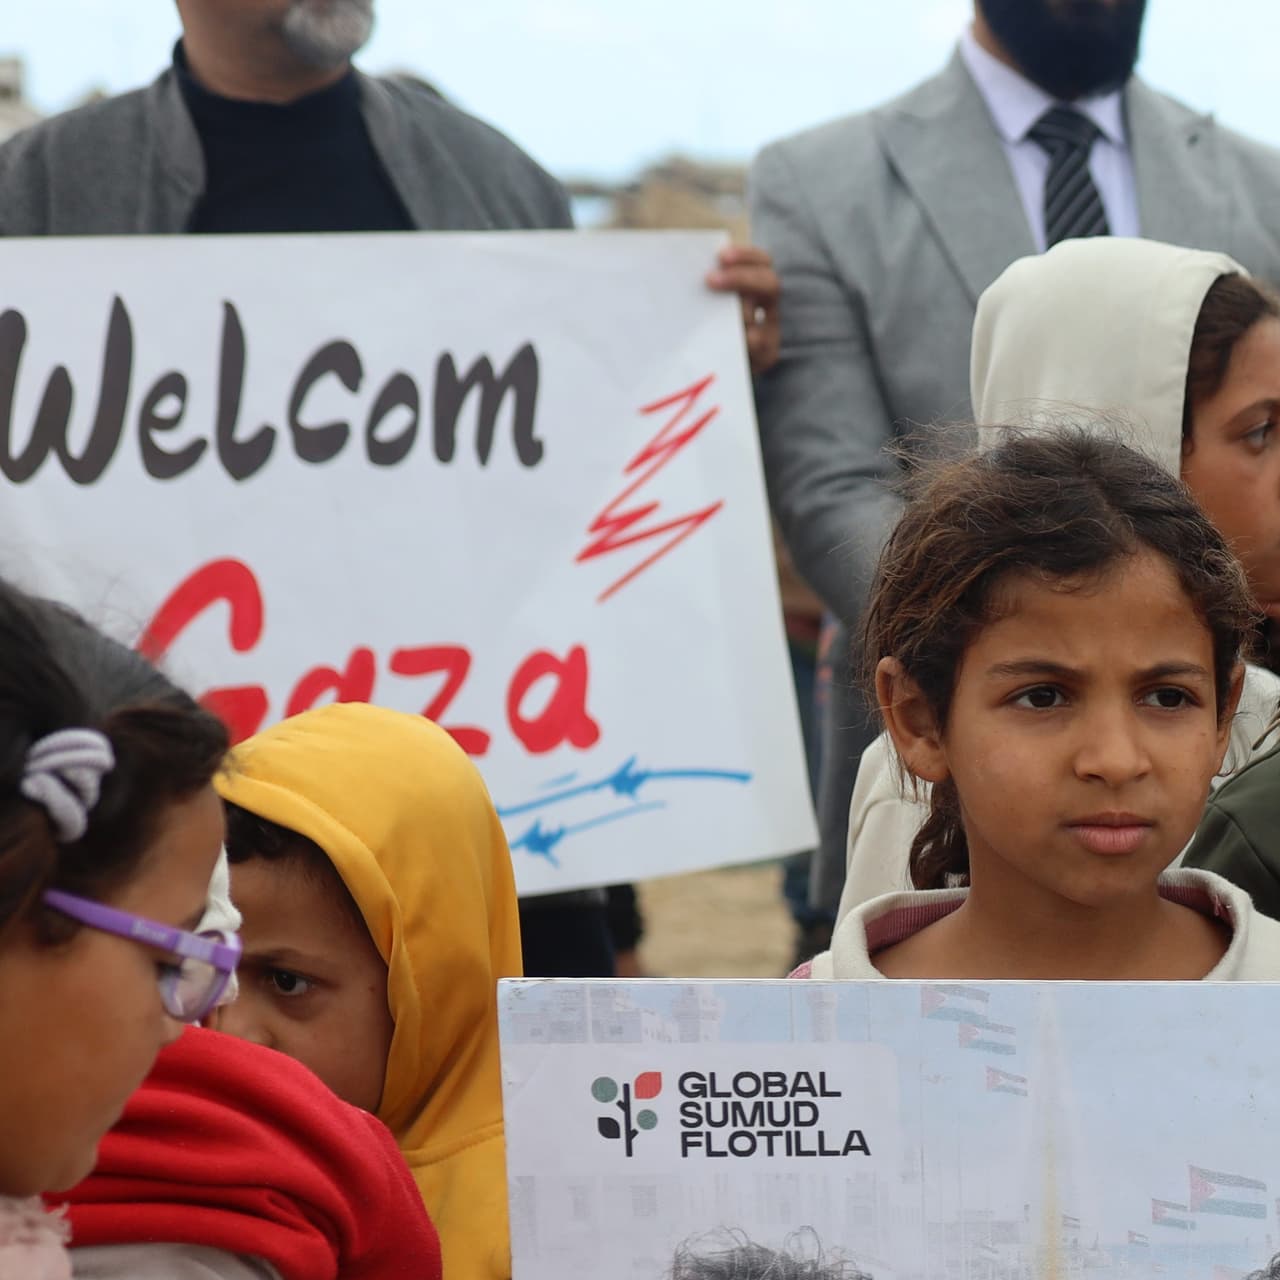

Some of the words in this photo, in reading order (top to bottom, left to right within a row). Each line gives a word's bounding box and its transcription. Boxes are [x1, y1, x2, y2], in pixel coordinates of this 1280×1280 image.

[0, 295, 544, 485] Welcom
[678, 1071, 842, 1099] GLOBAL
[679, 1101, 819, 1128] SUMUD
[680, 1130, 872, 1158] FLOTILLA
